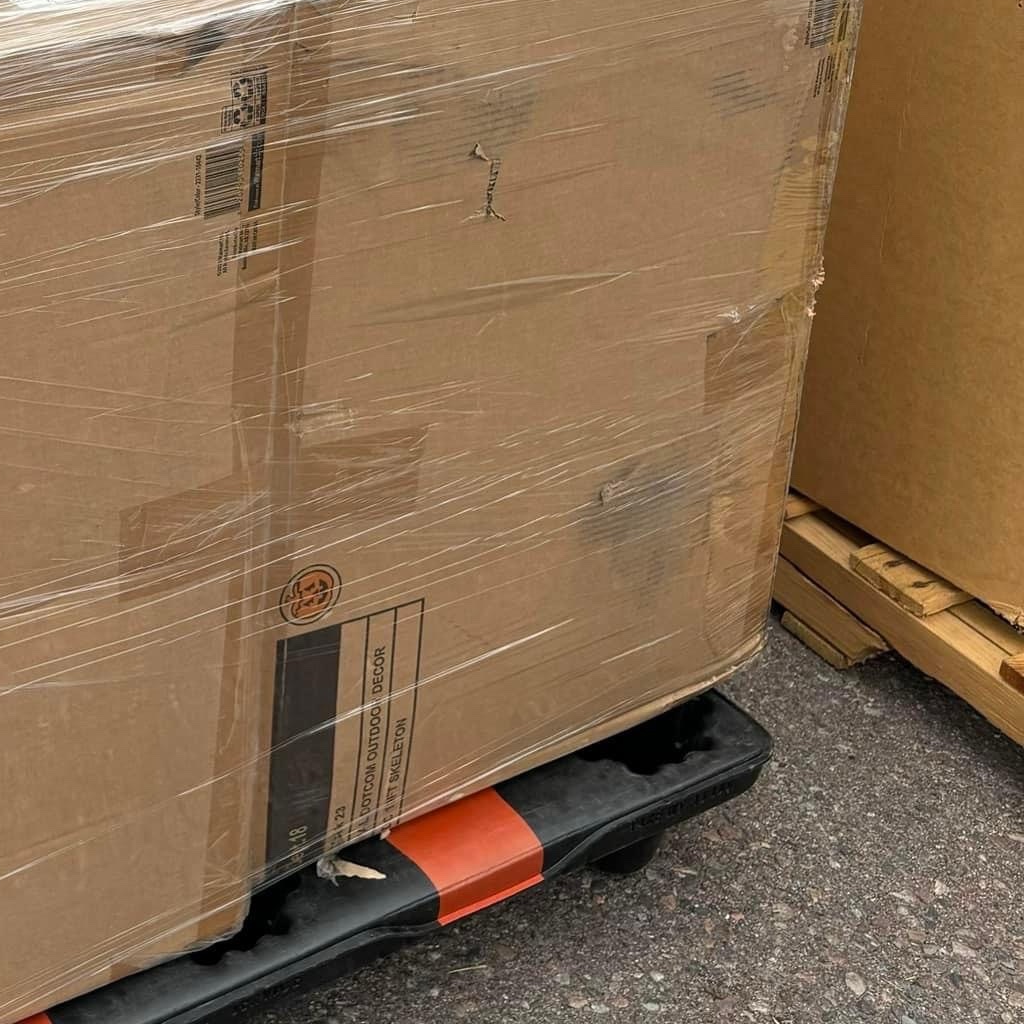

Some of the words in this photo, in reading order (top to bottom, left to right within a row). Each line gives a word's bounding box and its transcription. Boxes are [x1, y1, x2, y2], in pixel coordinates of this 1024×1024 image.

[373, 645, 387, 695] DECOR
[367, 696, 384, 761] OUTDOO
[388, 717, 407, 783] SKELETON
[334, 806, 346, 821] 23
[360, 763, 378, 816] DOTCOM
